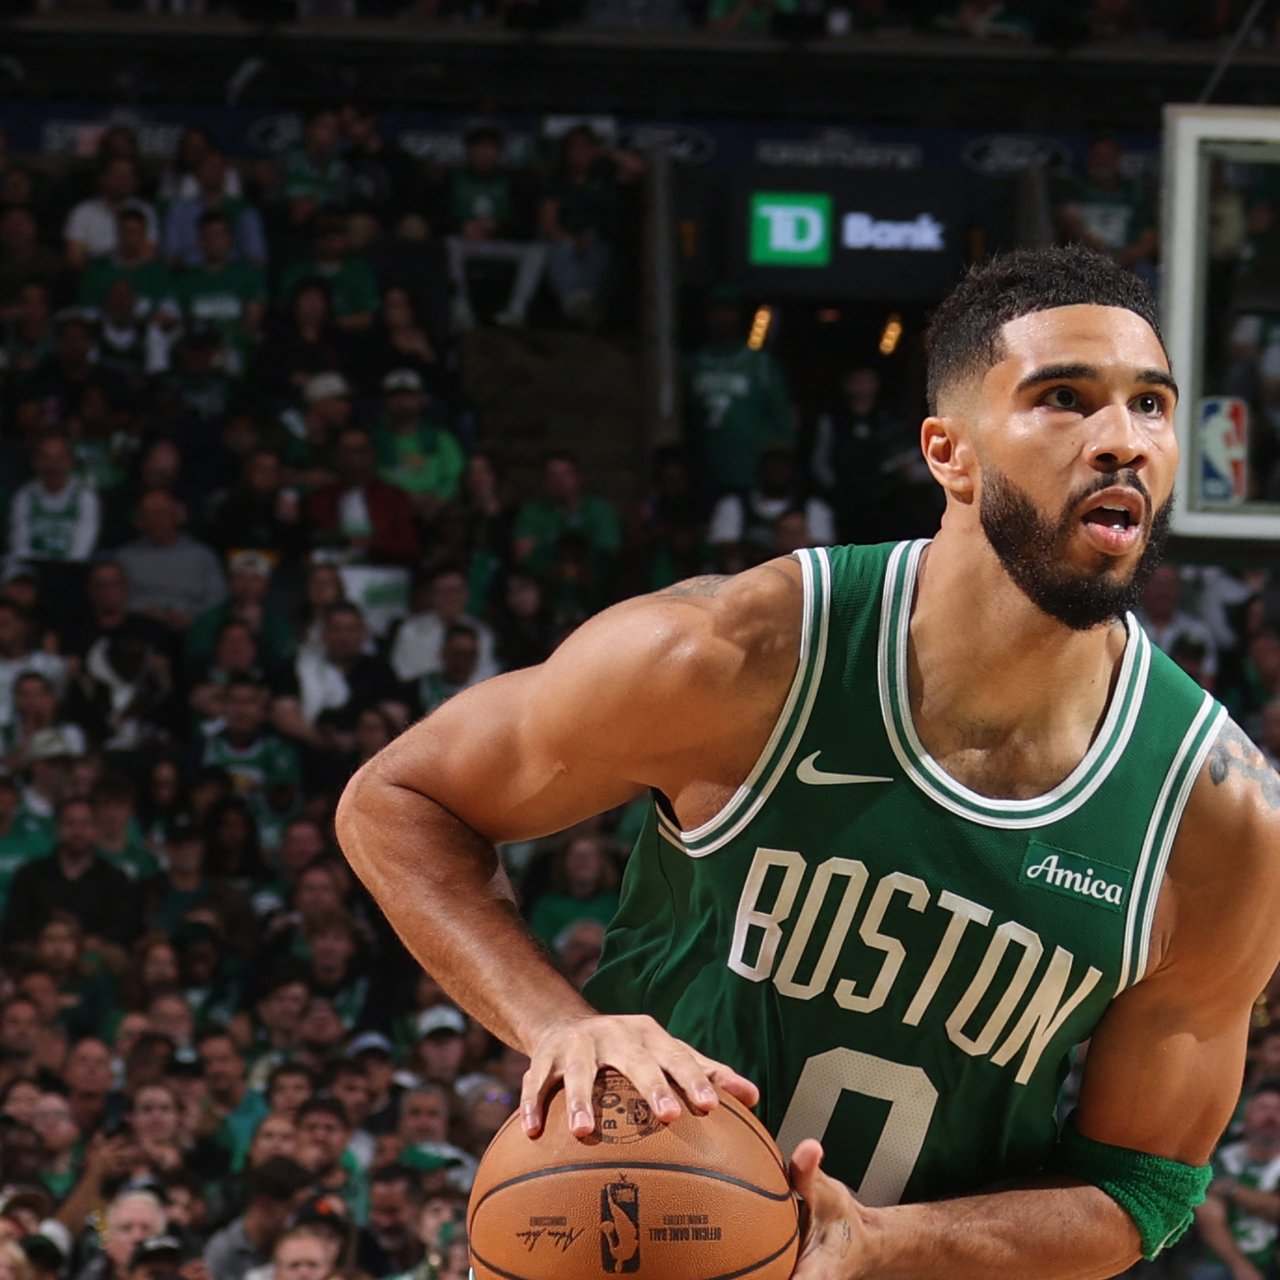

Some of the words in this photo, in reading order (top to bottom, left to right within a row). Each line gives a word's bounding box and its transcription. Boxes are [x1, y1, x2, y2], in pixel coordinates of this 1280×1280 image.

[757, 204, 824, 253] TD
[841, 211, 945, 251] Bank
[1026, 854, 1124, 905] Amica
[727, 847, 1103, 1086] BOSTON
[776, 1046, 939, 1206] 0
[649, 1228, 667, 1241] BALL
[668, 1227, 690, 1241] GAME
